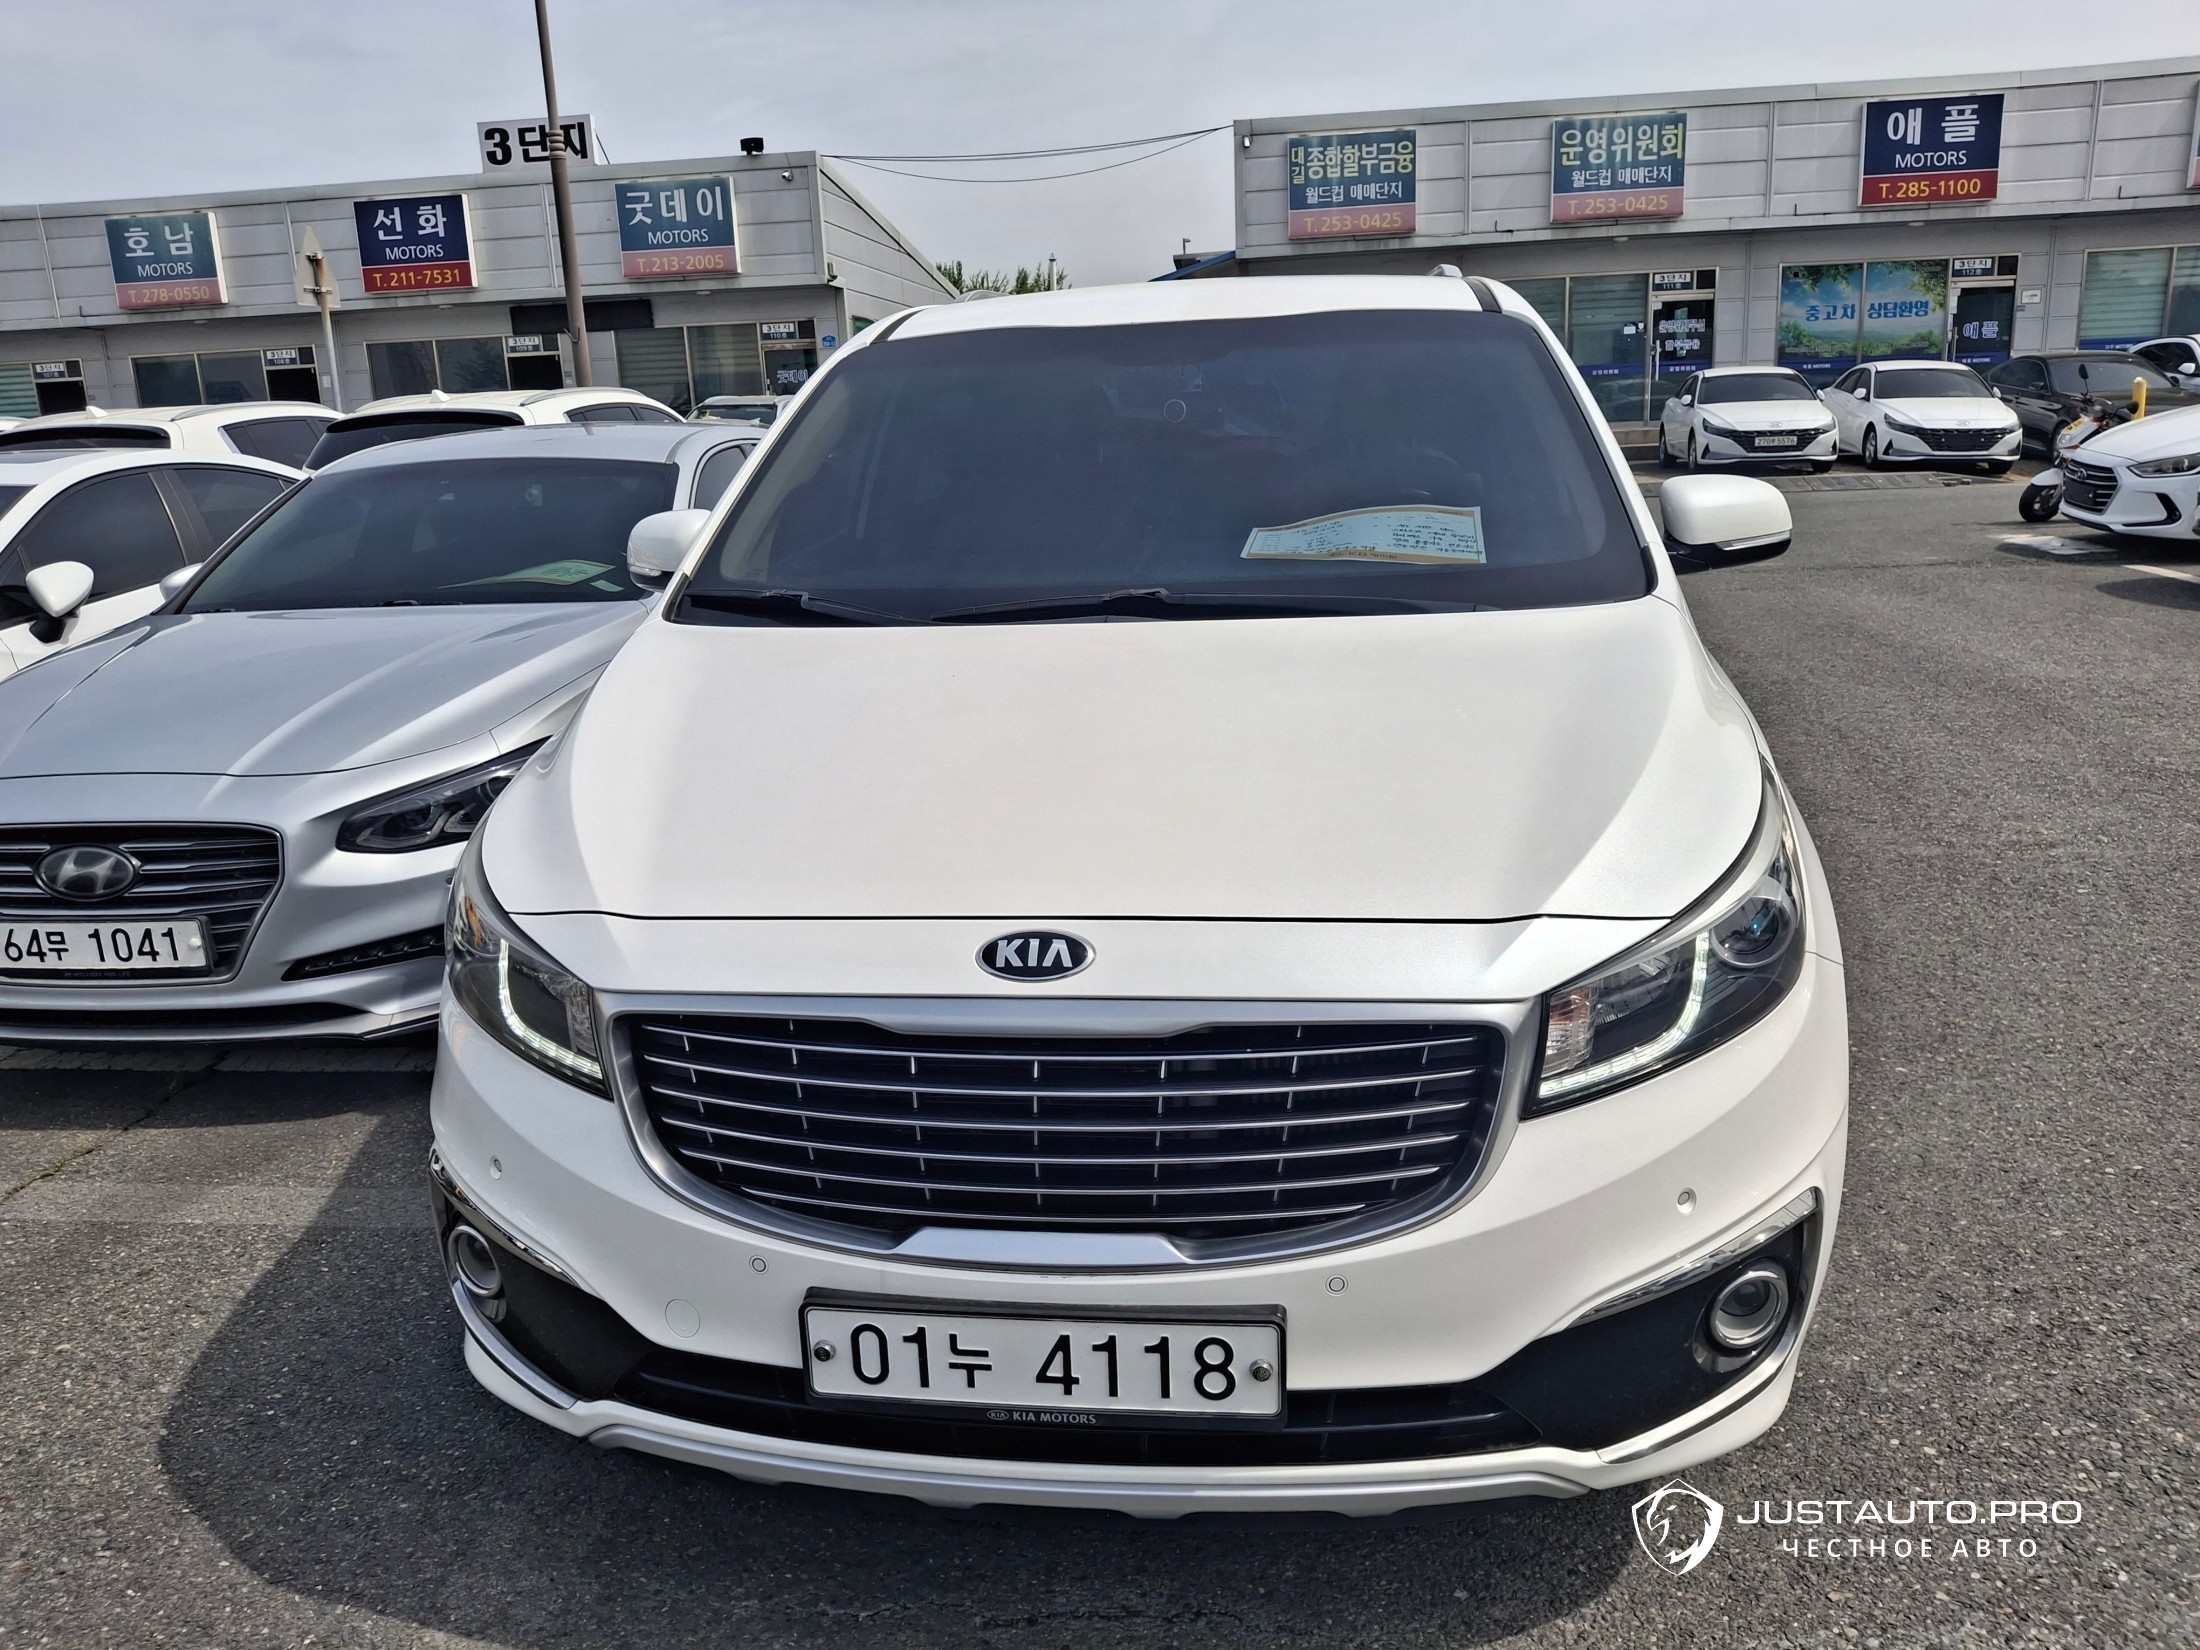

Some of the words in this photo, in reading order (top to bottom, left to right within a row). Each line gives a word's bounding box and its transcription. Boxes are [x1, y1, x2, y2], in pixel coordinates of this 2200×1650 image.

[1886, 104, 1980, 145] 애플
[484, 121, 588, 166] 3단지
[1560, 122, 1684, 166] 운영위원회
[1306, 140, 1414, 180] 종합할부금융
[1895, 150, 1967, 169] MOTORS
[1571, 168, 1612, 188] 월드컵
[1618, 165, 1672, 184] 매매단지
[1305, 184, 1344, 204] 월드컵
[1350, 181, 1402, 200] 매매단지
[1878, 178, 1981, 199] T.285-1100
[625, 186, 724, 226] 굿데이
[1568, 194, 1669, 215] T.253-0425
[373, 204, 447, 240] 선화
[1304, 211, 1402, 232] T.253-0425
[123, 222, 194, 257] 호남
[647, 228, 709, 245] MOTORS
[385, 243, 444, 260] MOTORS
[137, 261, 193, 277] MOTORS
[636, 254, 724, 273] T.213-2005
[1958, 259, 1988, 268] 3단지
[373, 268, 461, 288] T.211-7531
[1659, 273, 1687, 282] 3단지
[128, 286, 210, 304] T.278-0550
[1805, 303, 1857, 322] 중고차
[1867, 300, 1930, 319] 상담환영
[1962, 320, 1999, 340] 애플
[4, 928, 69, 963] 64무
[87, 927, 180, 963] 1041
[995, 938, 1073, 968] KIA
[850, 1323, 993, 1389] 01누
[1034, 1333, 1237, 1401] 4118
[1012, 1411, 1036, 1422] KIA
[1040, 1413, 1096, 1424] MOTORS
